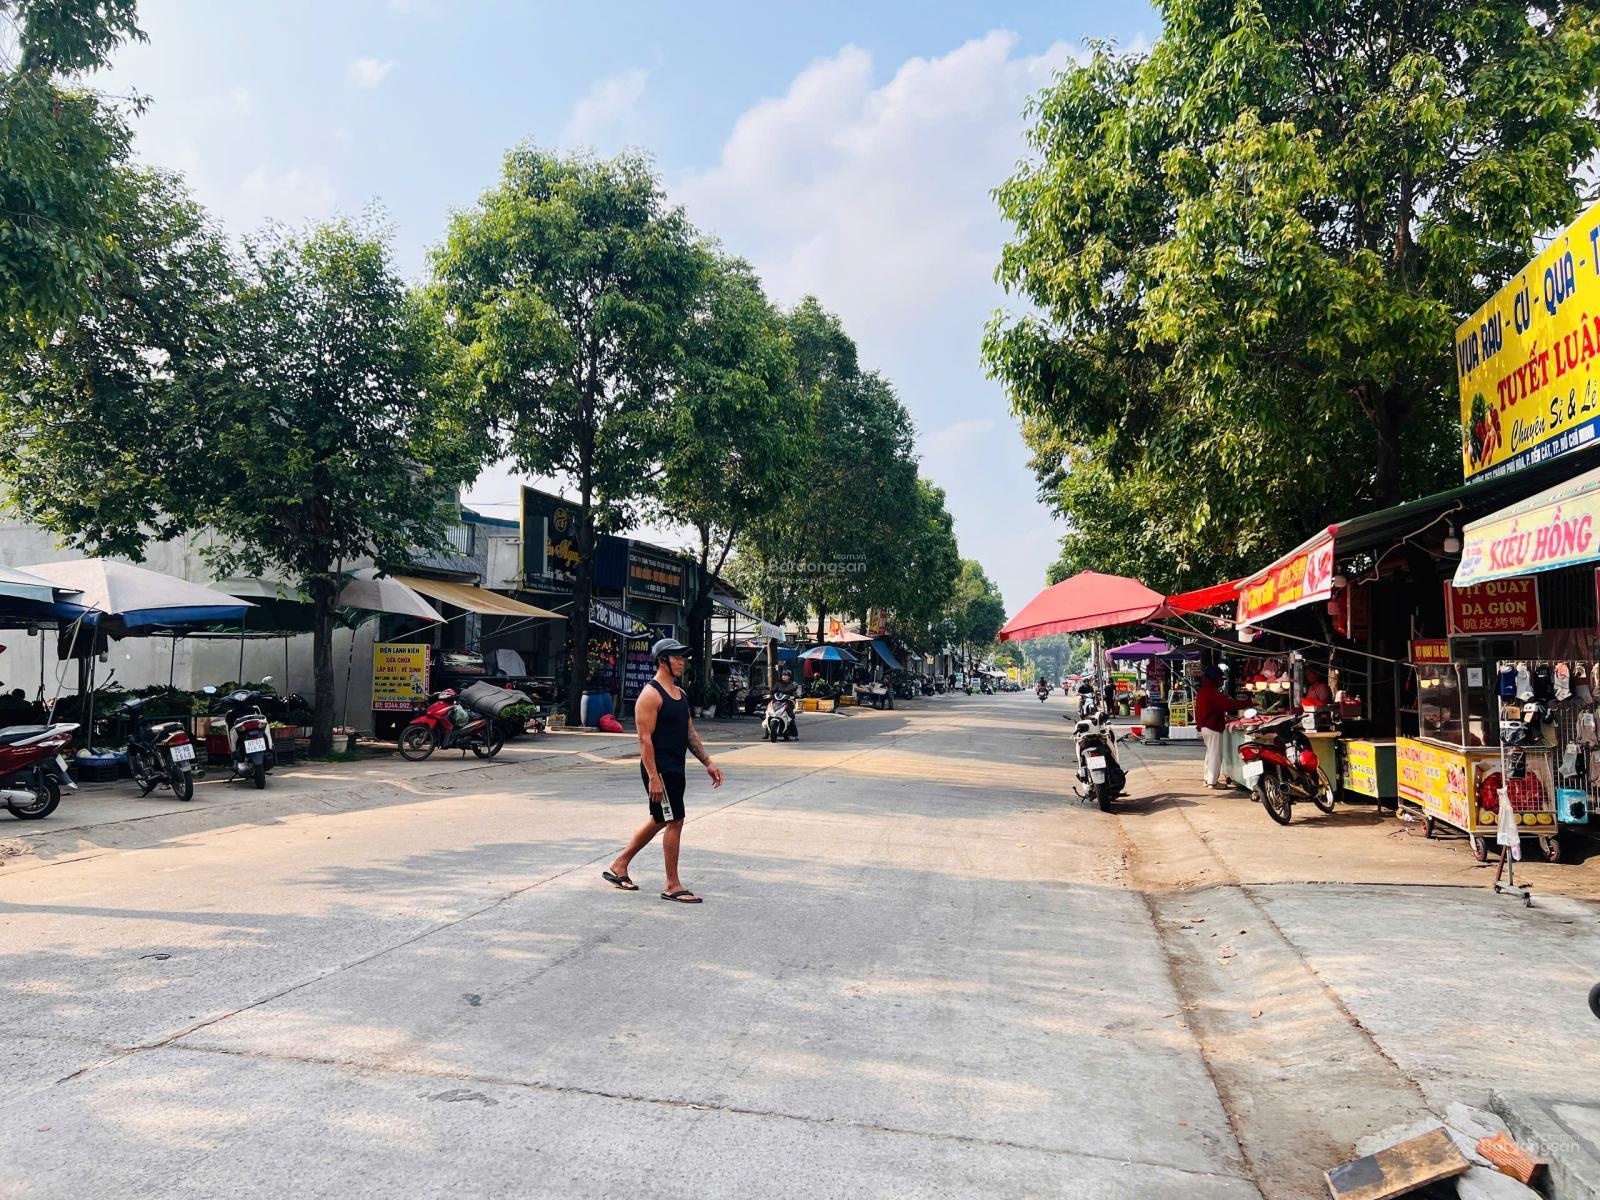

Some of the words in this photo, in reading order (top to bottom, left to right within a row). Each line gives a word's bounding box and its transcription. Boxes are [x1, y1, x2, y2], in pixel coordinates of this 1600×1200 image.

[1458, 331, 1479, 382] VỰA
[1481, 310, 1502, 362] RAU
[1514, 275, 1530, 335] CỦ
[1544, 237, 1575, 316] QUẢ
[1497, 340, 1550, 412] TUYẾT
[1511, 415, 1545, 452] Chuyên
[1567, 387, 1576, 420] &
[1531, 504, 1592, 562] HỒNG
[1461, 602, 1484, 615] DA
[1488, 598, 1527, 614] GIÒN
[1485, 580, 1530, 596] QUAY
[596, 603, 608, 623] TÓC
[608, 610, 622, 630] NAM
[628, 641, 649, 652] NAM
